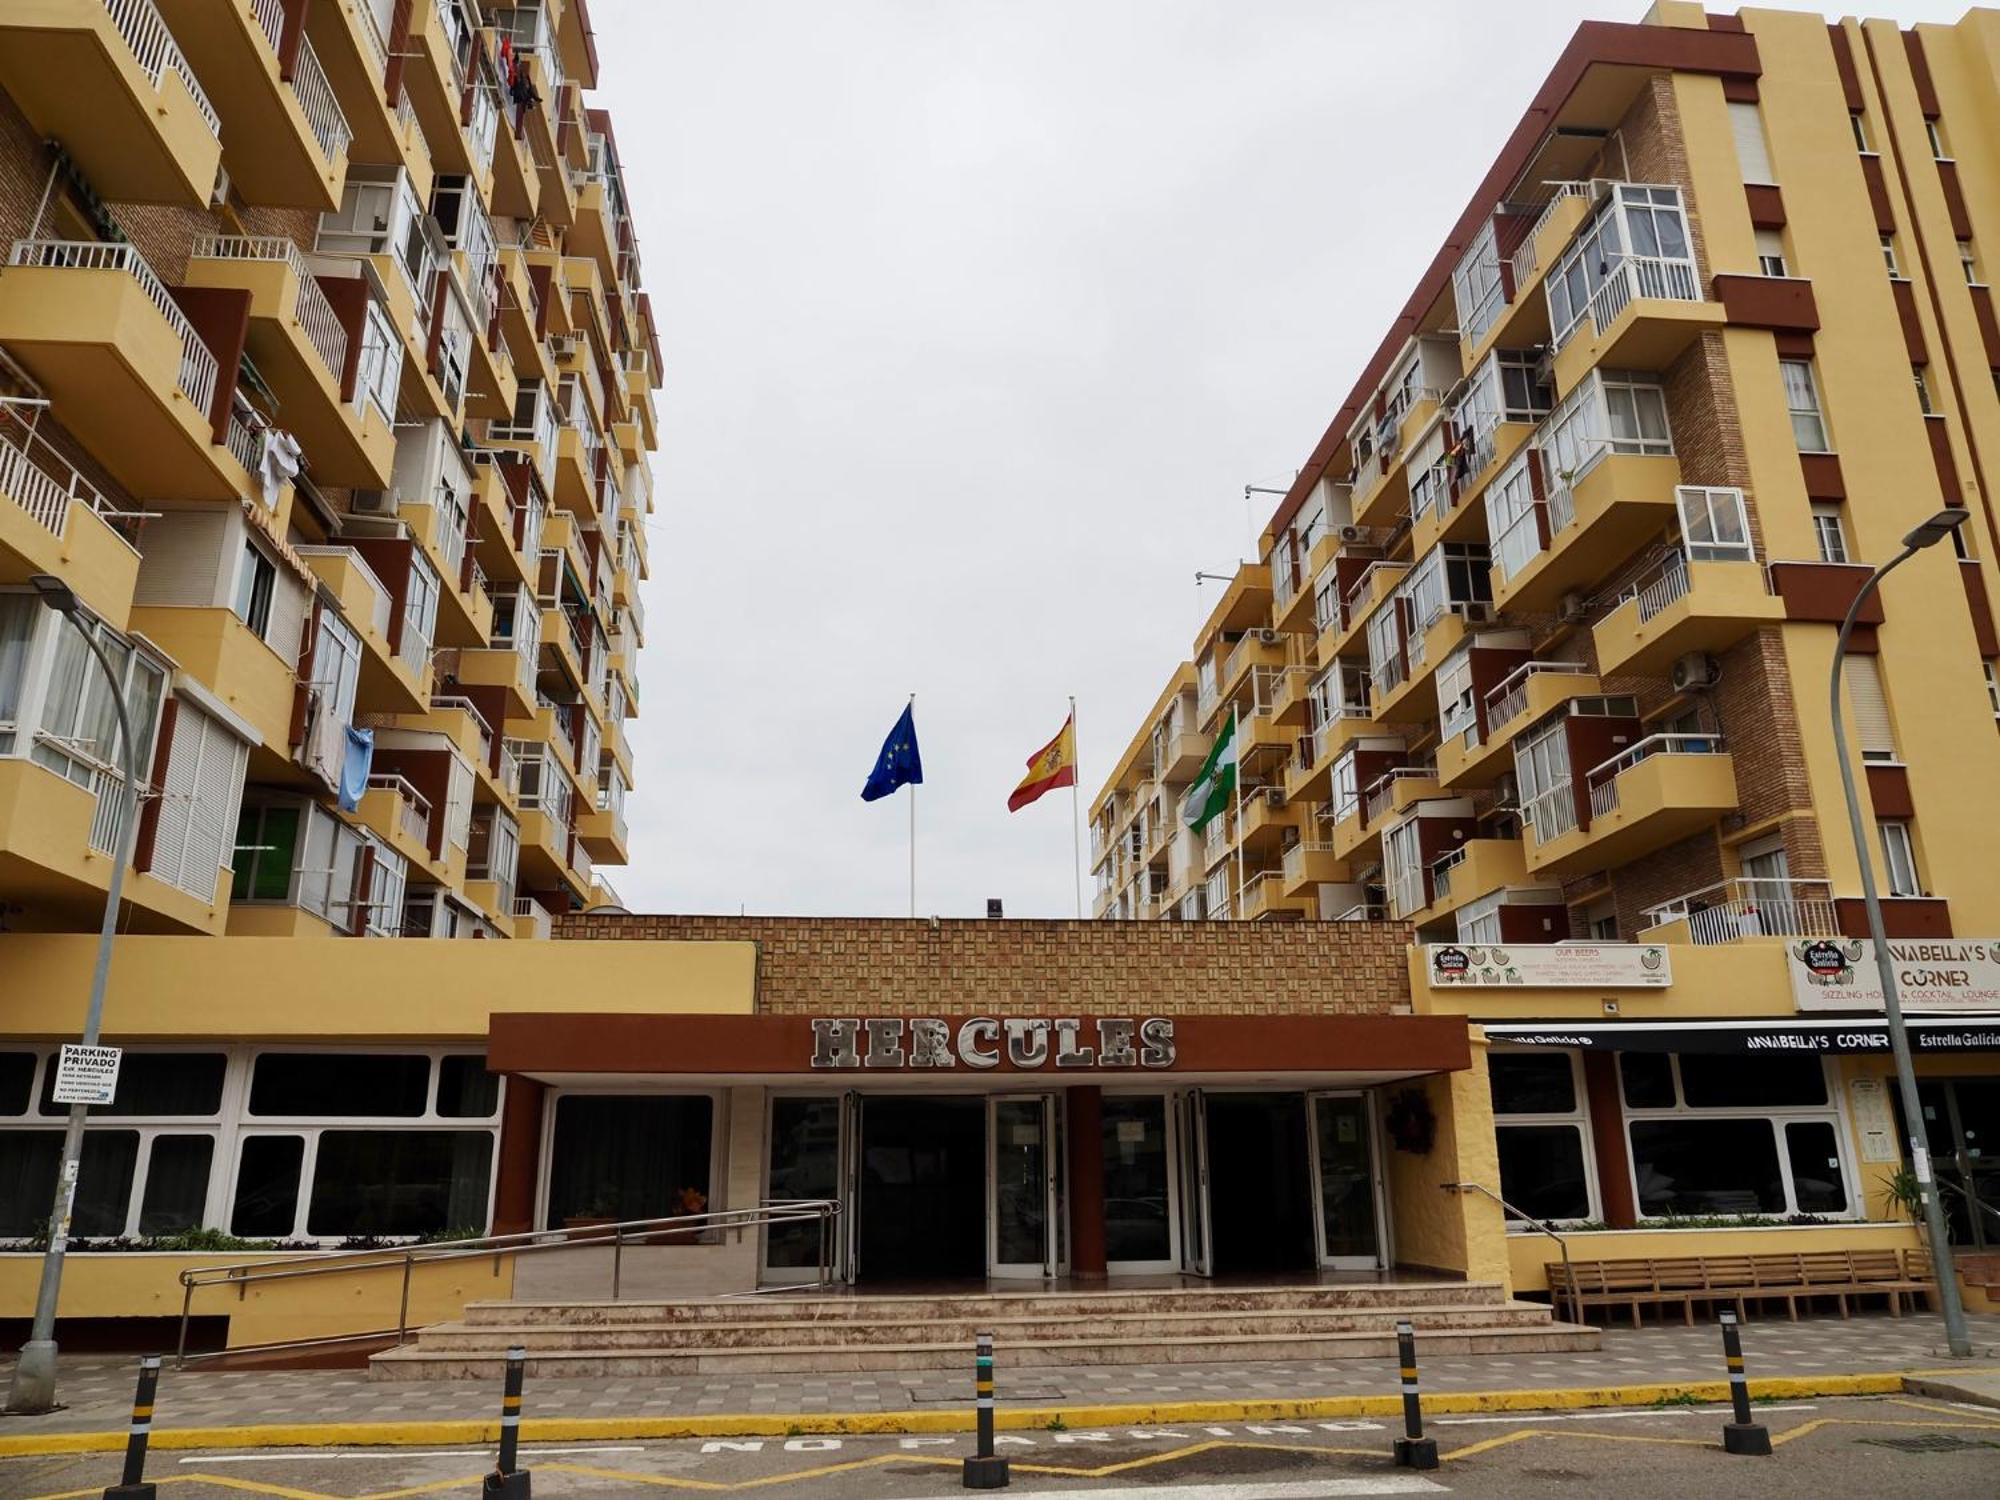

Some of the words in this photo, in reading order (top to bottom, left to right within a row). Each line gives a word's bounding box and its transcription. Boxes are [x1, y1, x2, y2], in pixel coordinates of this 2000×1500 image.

[811, 1017, 1177, 1068] HERCULES
[1747, 1035, 1830, 1049] ANNABELLA'S
[1836, 1034, 1890, 1047] CORNER
[1920, 1034, 1961, 1047] Estrella
[1962, 1033, 2000, 1046] Galicia
[65, 1047, 117, 1058] PARKING
[64, 1056, 116, 1067] PRIVADO
[700, 1439, 842, 1453] NO
[900, 1421, 1388, 1449] PARKING
